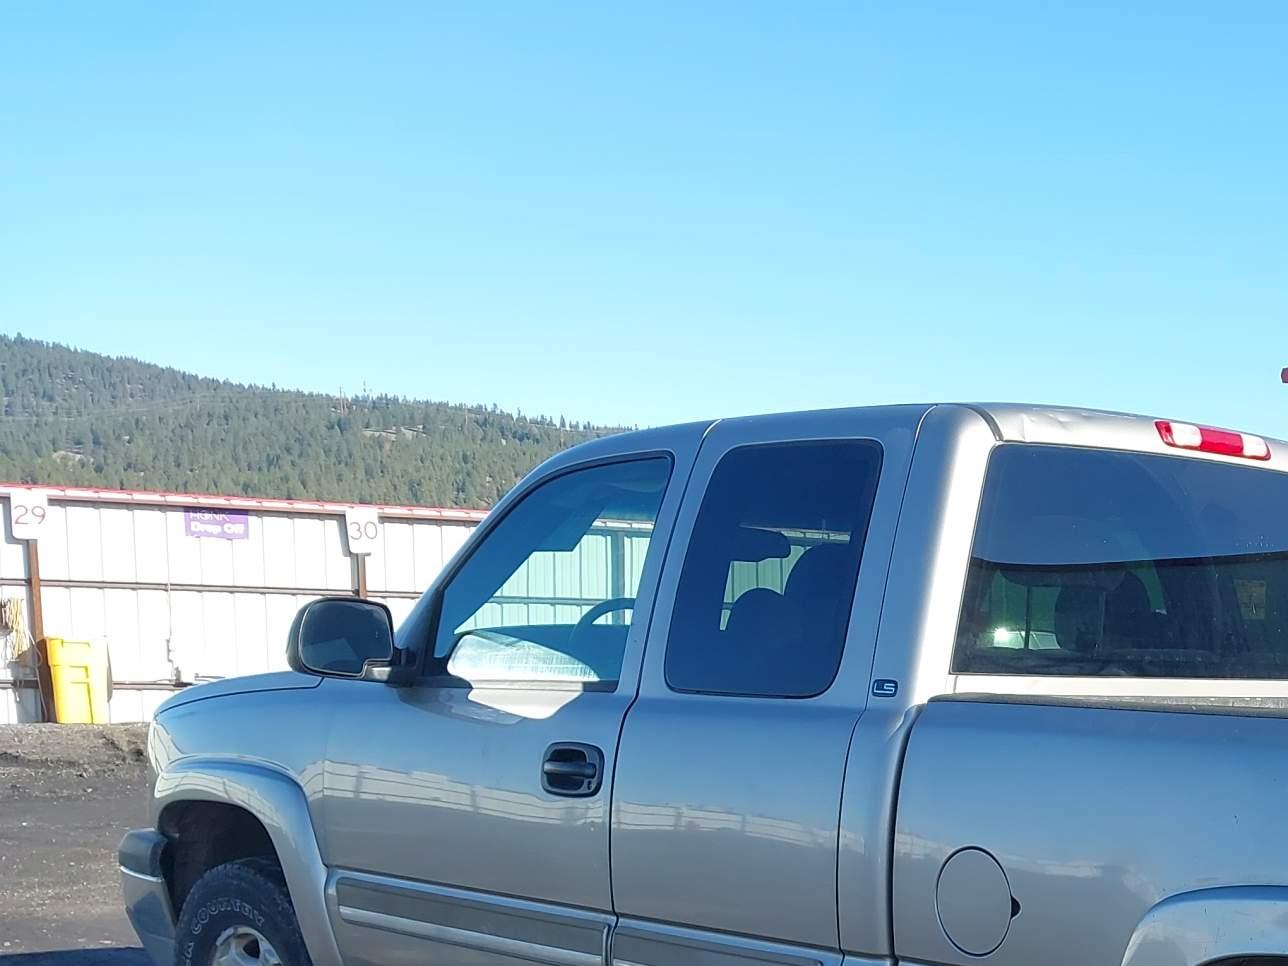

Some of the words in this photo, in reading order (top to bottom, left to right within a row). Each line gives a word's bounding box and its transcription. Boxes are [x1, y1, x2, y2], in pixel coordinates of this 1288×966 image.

[14, 504, 46, 525] 29
[350, 521, 378, 540] 30
[873, 682, 896, 694] LS
